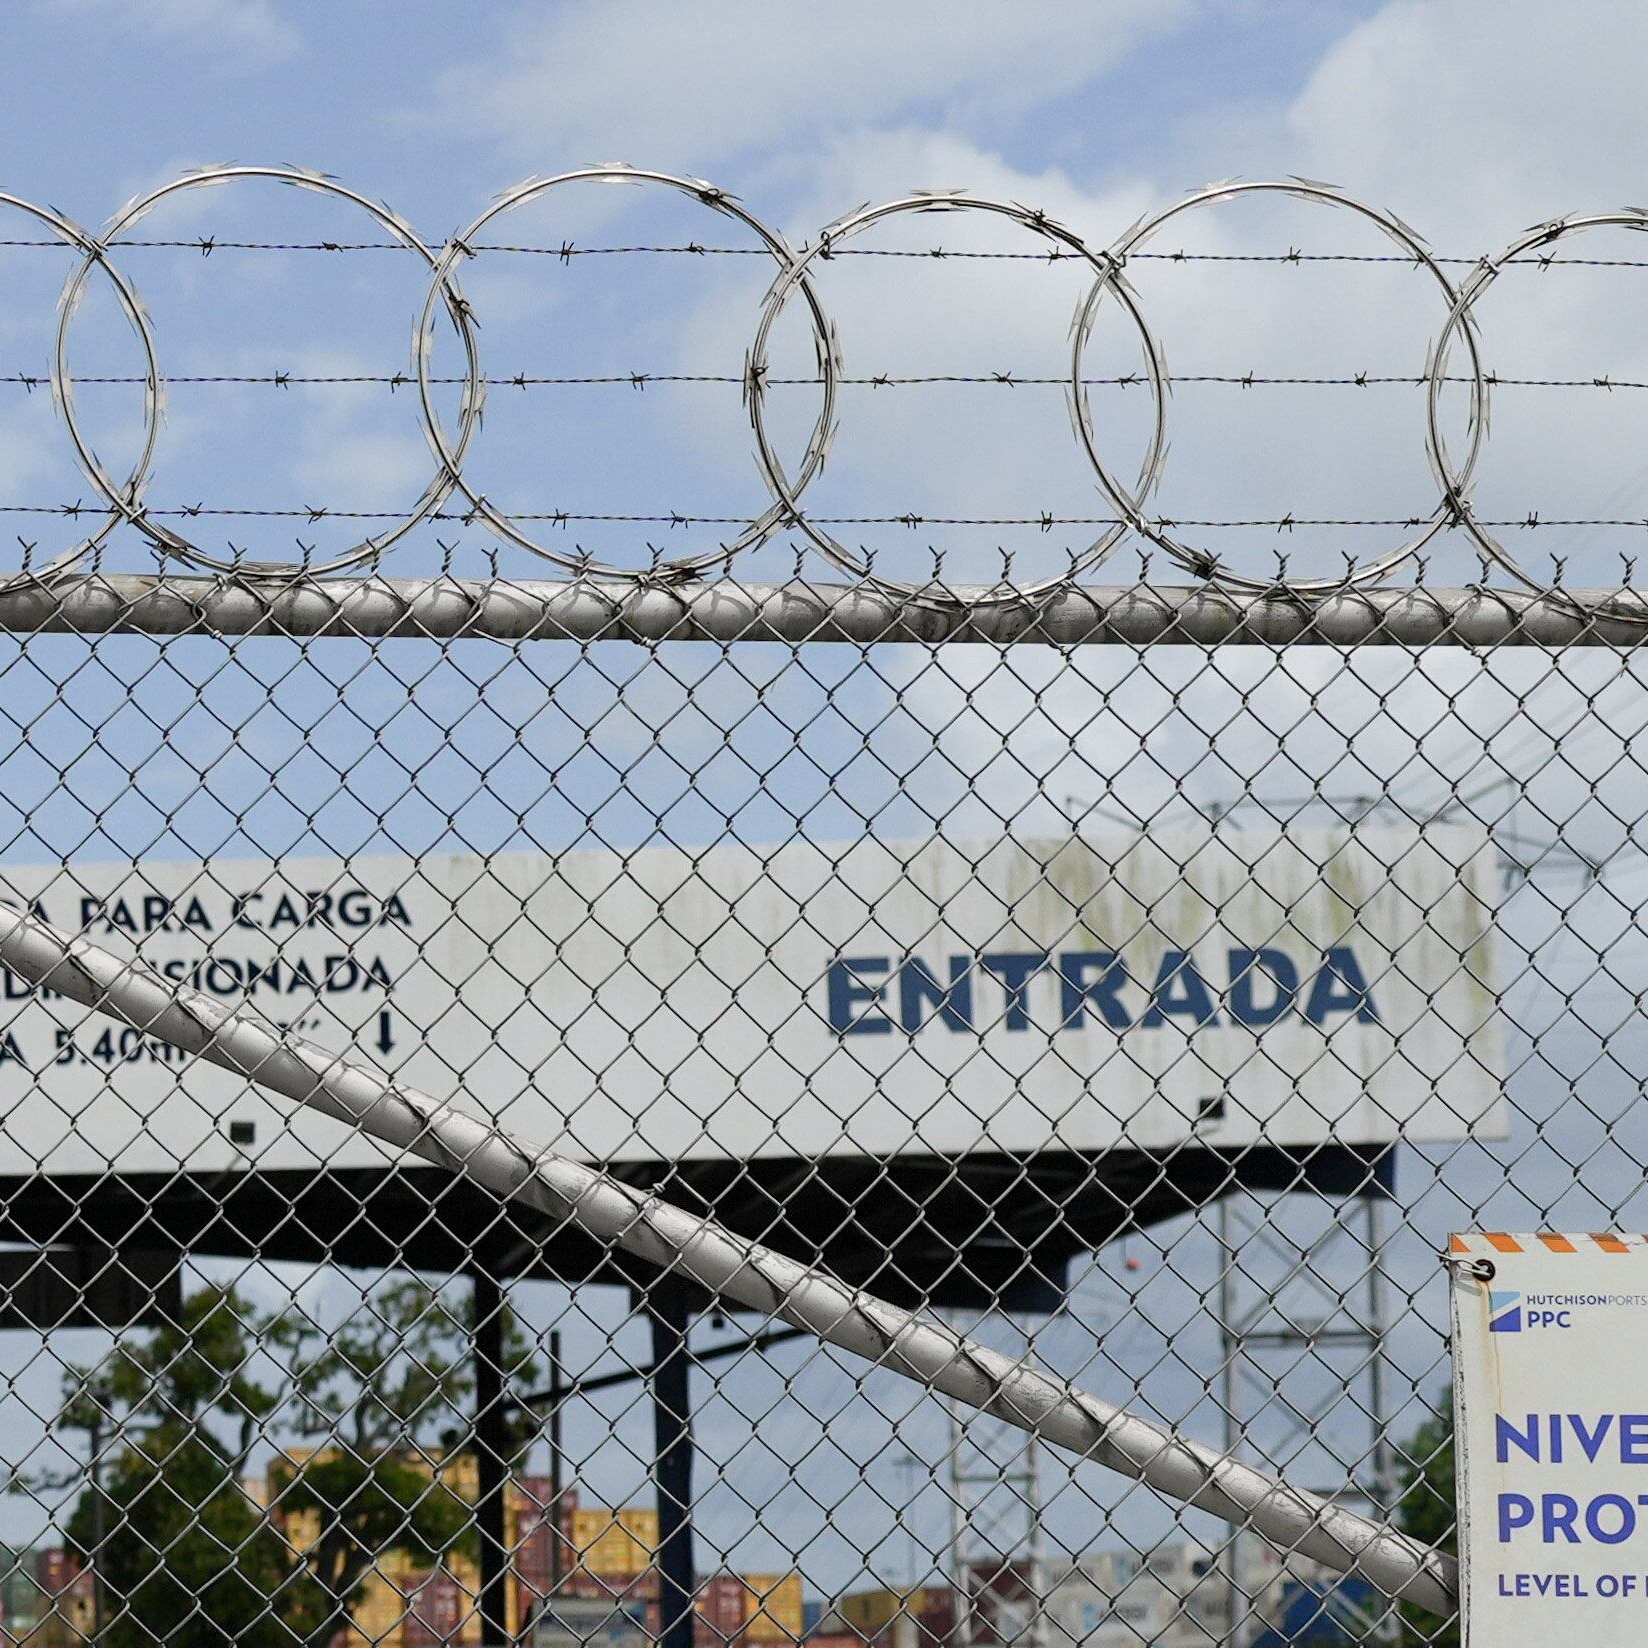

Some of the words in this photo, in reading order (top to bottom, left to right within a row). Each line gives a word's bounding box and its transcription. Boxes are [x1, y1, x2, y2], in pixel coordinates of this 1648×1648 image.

[80, 896, 213, 934] PARA
[231, 891, 412, 929] CARGA
[826, 947, 1383, 1036] ENTRADA
[1528, 1311, 1571, 1328] PPC
[1498, 1574, 1588, 1597] LEVEL
[1596, 1574, 1636, 1597] OF
